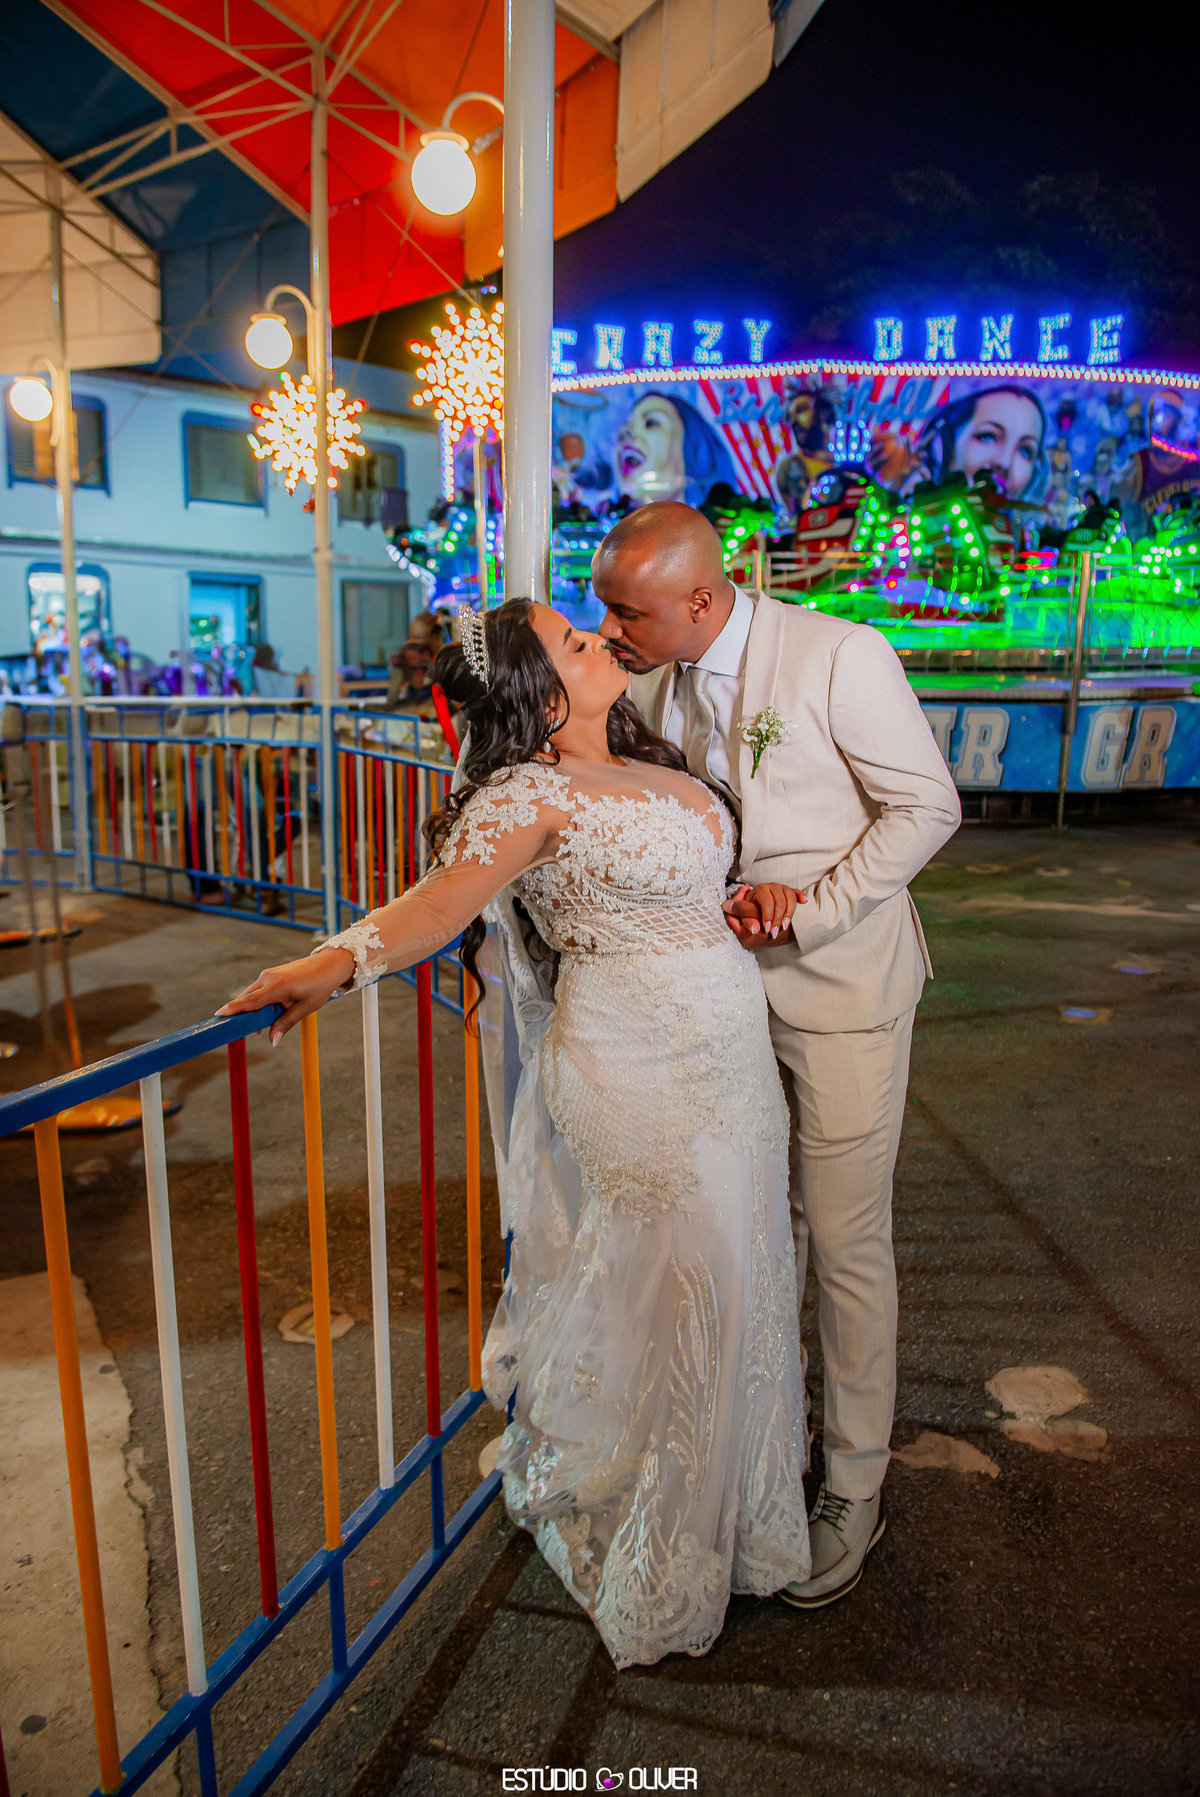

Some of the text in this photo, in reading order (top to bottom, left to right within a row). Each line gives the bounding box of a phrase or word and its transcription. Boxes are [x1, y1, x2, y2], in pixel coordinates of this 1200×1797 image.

[552, 312, 1125, 375] CRAZY DANCE
[1080, 704, 1177, 788] GR
